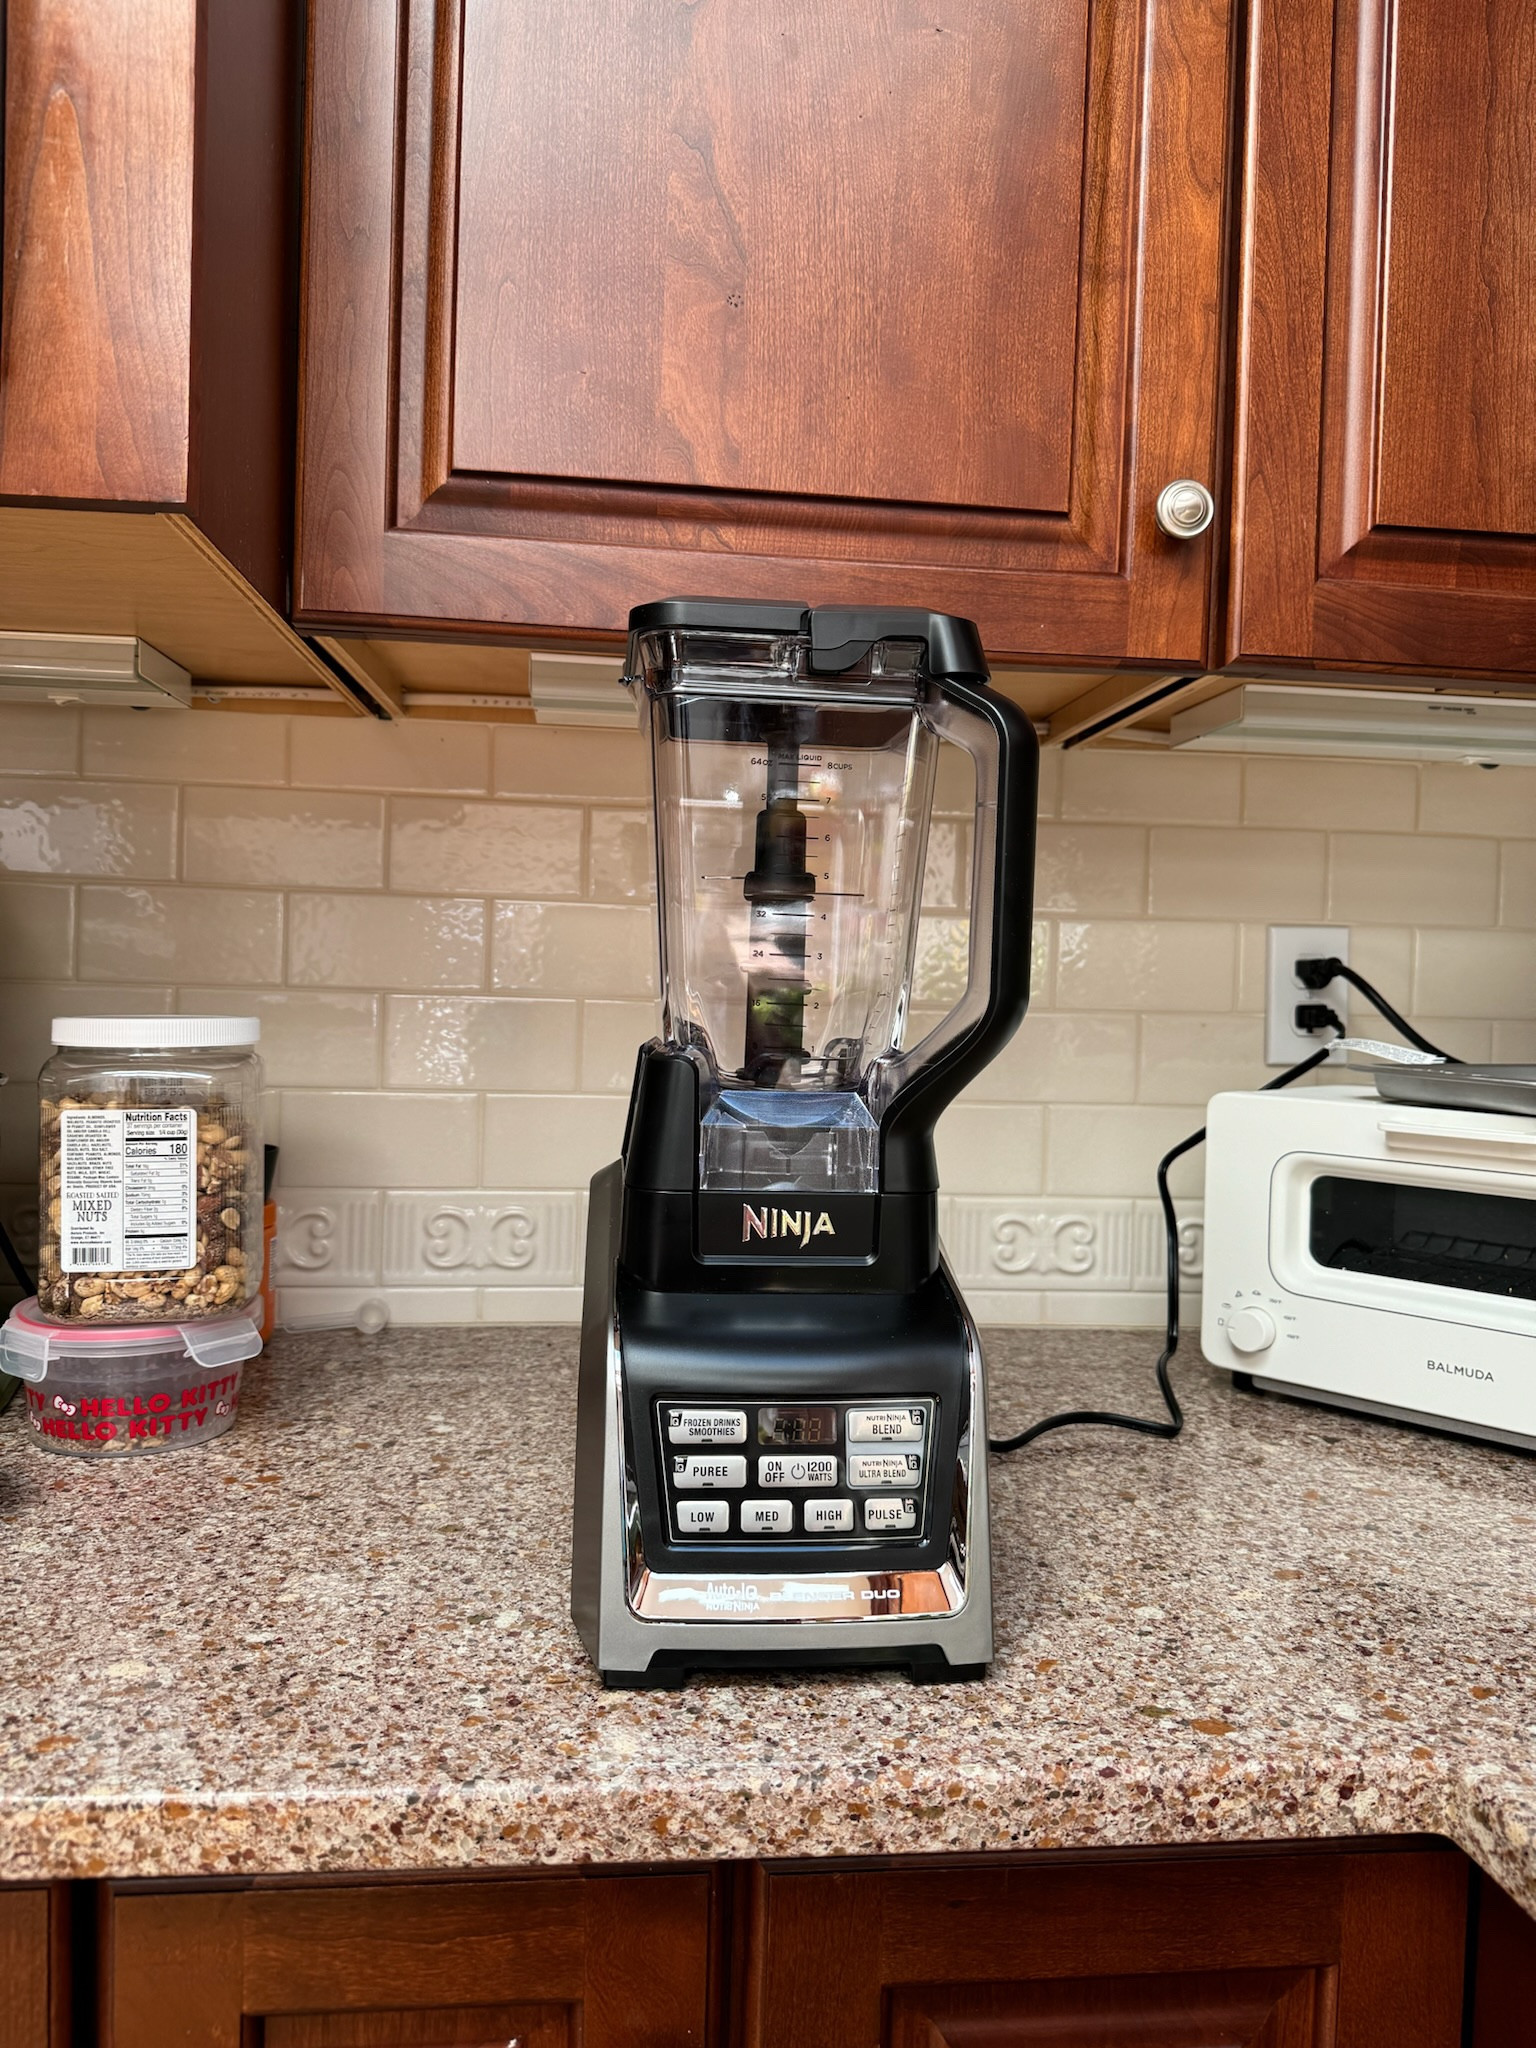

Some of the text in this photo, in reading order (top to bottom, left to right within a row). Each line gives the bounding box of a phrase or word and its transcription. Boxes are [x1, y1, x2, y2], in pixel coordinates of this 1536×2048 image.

[826, 797, 831, 805] 7
[824, 834, 831, 842] 6
[756, 910, 767, 918] 32
[752, 950, 764, 958] 24
[813, 1002, 819, 1010] 2
[125, 1111, 188, 1122] Nutrition Facts
[125, 1143, 188, 1155] Calories 180
[72, 1199, 113, 1211] MIXED
[77, 1211, 108, 1222] NUTS
[742, 1203, 836, 1249] NINJA
[1427, 1359, 1495, 1382] BALMUDA
[80, 1393, 171, 1417] HELLO
[181, 1372, 239, 1409] KITTY
[42, 1407, 208, 1441] HELLO KITTY
[683, 1418, 712, 1427] FROZEN
[713, 1418, 741, 1427] DRINKS
[688, 1427, 736, 1436] SMOOTHIES
[872, 1424, 902, 1435] BLEND
[693, 1466, 729, 1477] PUREE
[767, 1461, 782, 1472] ON
[807, 1461, 832, 1472] 1200
[765, 1472, 785, 1483] OFF
[807, 1473, 833, 1481] WATTS
[858, 1469, 907, 1479] ULTRA BLEND
[690, 1512, 715, 1523] LOW
[755, 1511, 779, 1522] MED
[816, 1510, 842, 1521] HIGH
[868, 1509, 902, 1520] PULSE
[769, 1589, 900, 1602] BENDER DUO
